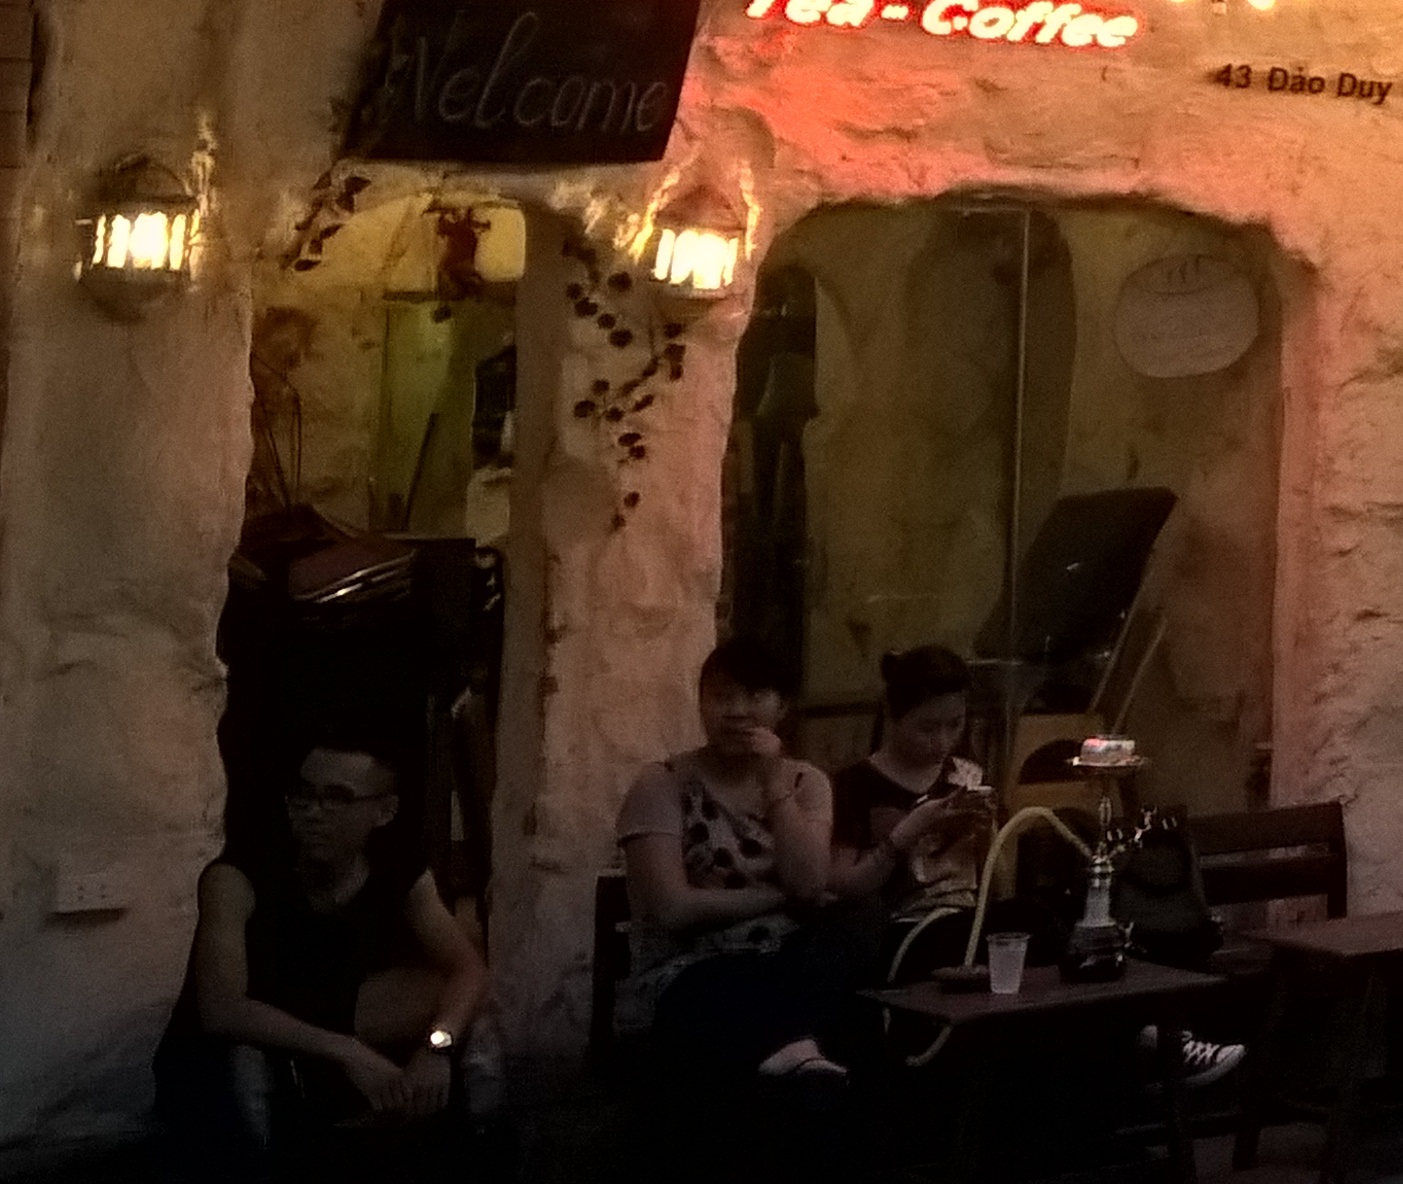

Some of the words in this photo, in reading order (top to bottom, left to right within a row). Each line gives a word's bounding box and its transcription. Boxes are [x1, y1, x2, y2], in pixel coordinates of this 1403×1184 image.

[384, 10, 668, 134] Welcome
[1212, 62, 1253, 90] 43
[1337, 72, 1393, 106] Duy
